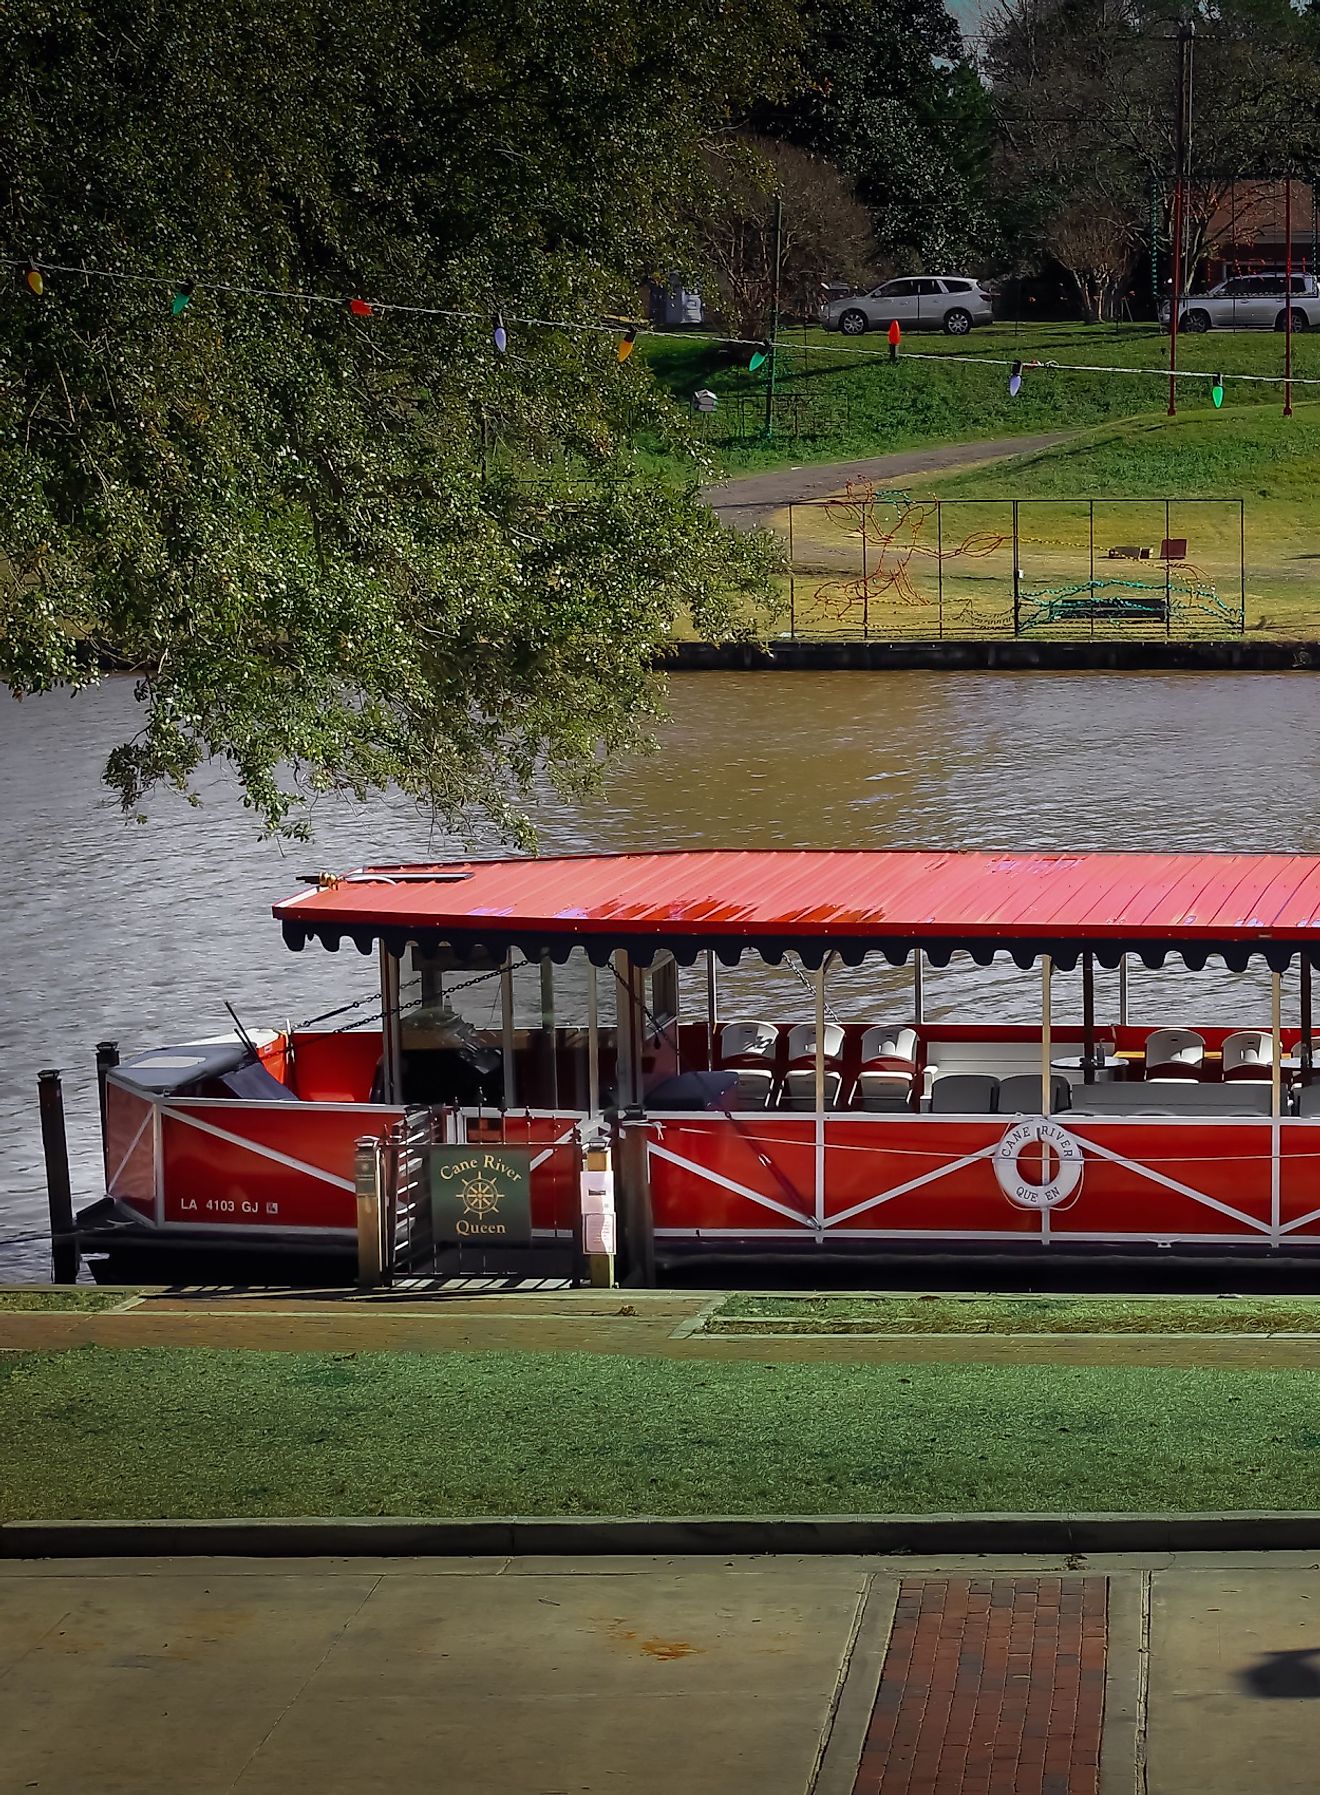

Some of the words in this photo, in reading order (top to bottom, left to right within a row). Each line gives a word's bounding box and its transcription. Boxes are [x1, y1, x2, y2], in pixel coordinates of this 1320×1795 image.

[1001, 1126, 1031, 1157] CANE
[1041, 1125, 1073, 1157] RIVER
[440, 1159, 478, 1180] Cane
[483, 1154, 522, 1182] River
[180, 1197, 198, 1210] LA
[206, 1199, 235, 1212] 4103
[241, 1201, 259, 1213] GJ
[456, 1219, 506, 1236] Queen
